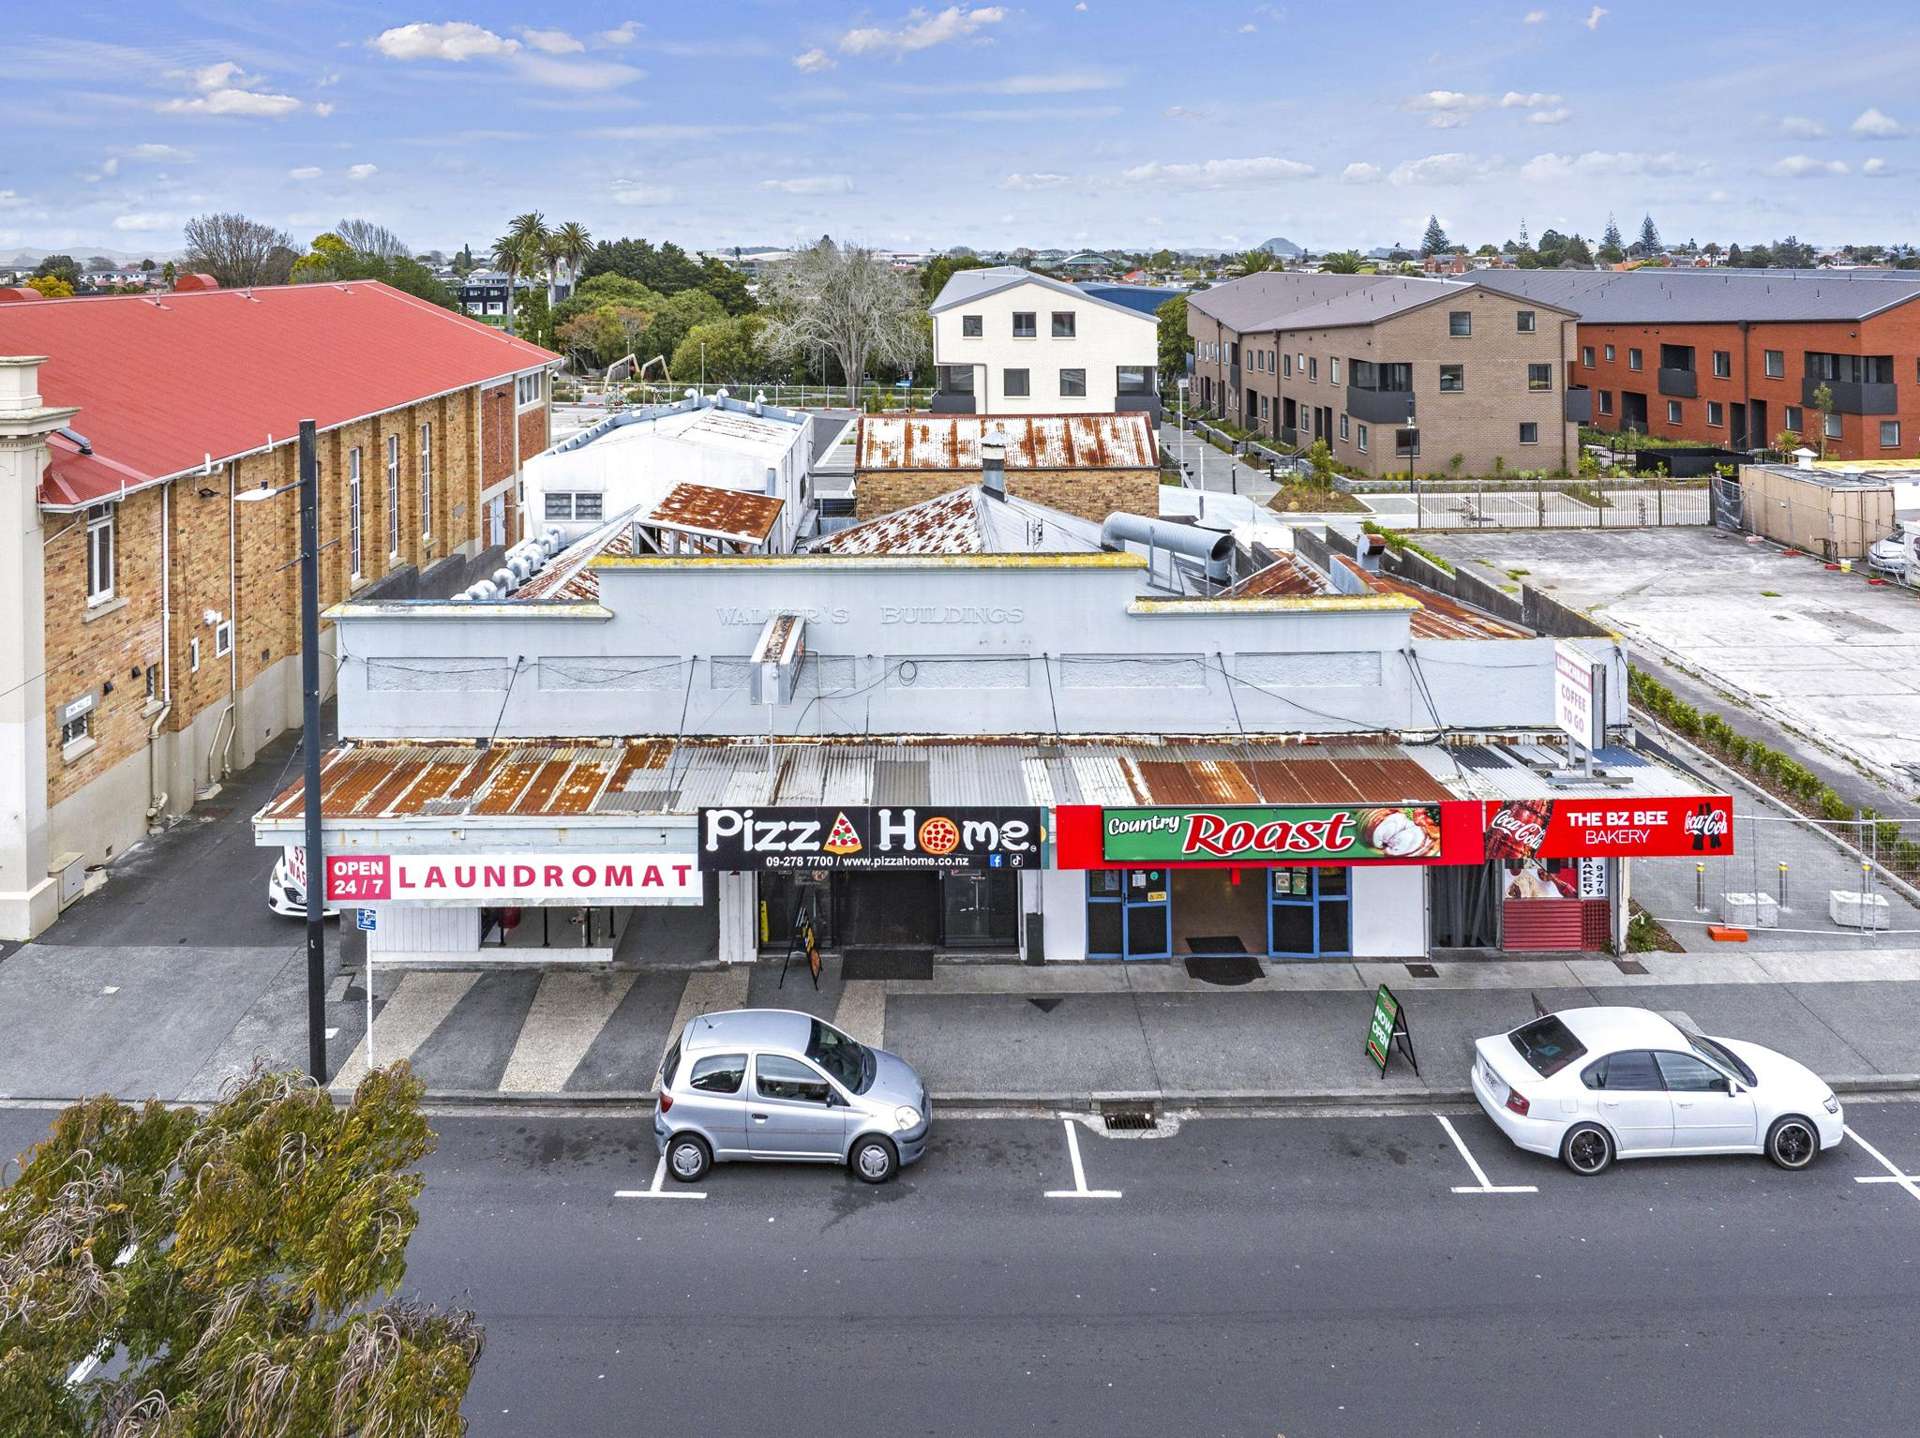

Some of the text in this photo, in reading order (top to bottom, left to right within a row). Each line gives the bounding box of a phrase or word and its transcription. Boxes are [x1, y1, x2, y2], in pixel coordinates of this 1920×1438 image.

[880, 606, 1025, 625] BUILDINGS
[1561, 684, 1586, 712] COFFEE
[1563, 706, 1584, 733] TO GO
[1567, 811, 1668, 827] THE BZ BEE
[1108, 812, 1357, 857] Country Roast
[1585, 829, 1651, 845] BAKERY
[333, 861, 384, 876] OPEN
[766, 856, 804, 867] 09-278
[806, 856, 834, 867] 7700
[843, 856, 969, 868] www.pizzahome.co.nz
[399, 864, 693, 888] LAUNDROMAT
[1583, 857, 1593, 895] BAKERY
[1375, 1005, 1393, 1034] NOW
[1372, 1020, 1390, 1050] OPEN
